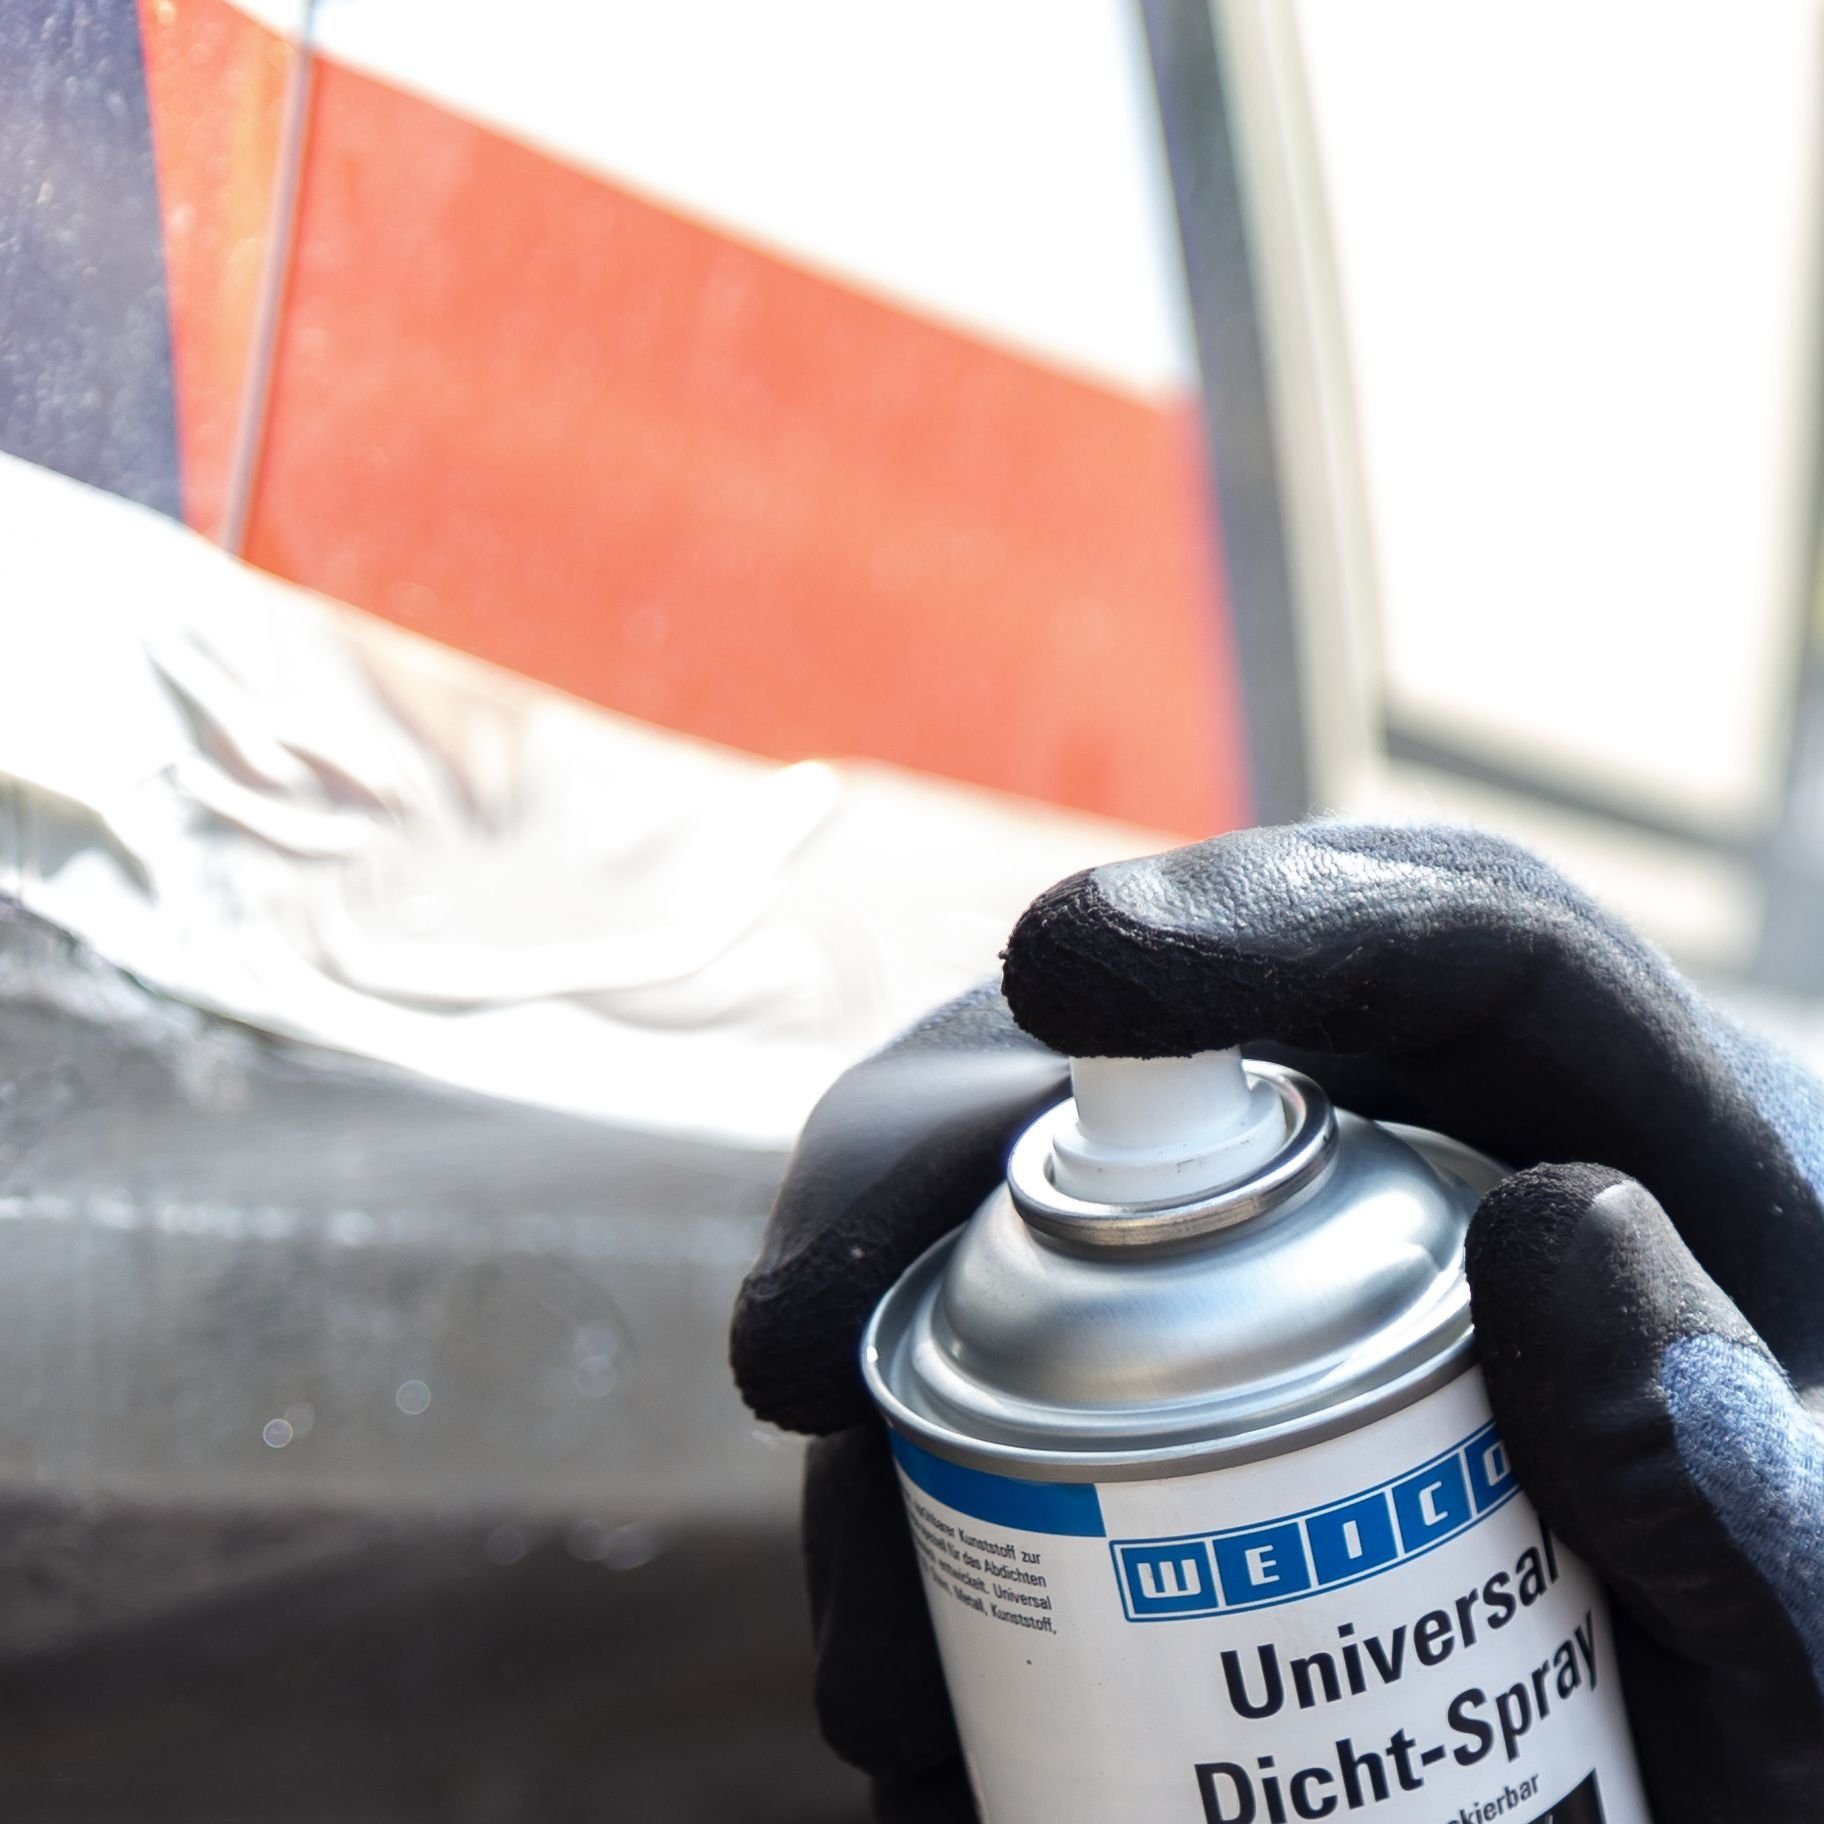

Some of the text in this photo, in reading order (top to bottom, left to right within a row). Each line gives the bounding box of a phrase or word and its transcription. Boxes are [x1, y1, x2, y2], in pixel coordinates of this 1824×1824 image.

[958, 1528, 1016, 1560] Kunststoff
[1020, 1550, 1041, 1565] zur
[962, 1551, 982, 1570] das
[984, 1559, 1047, 1589] Abdichten
[993, 1583, 1053, 1610] Universal
[990, 1603, 1057, 1635] Kunststoff,
[1220, 1514, 1559, 1719] Universal
